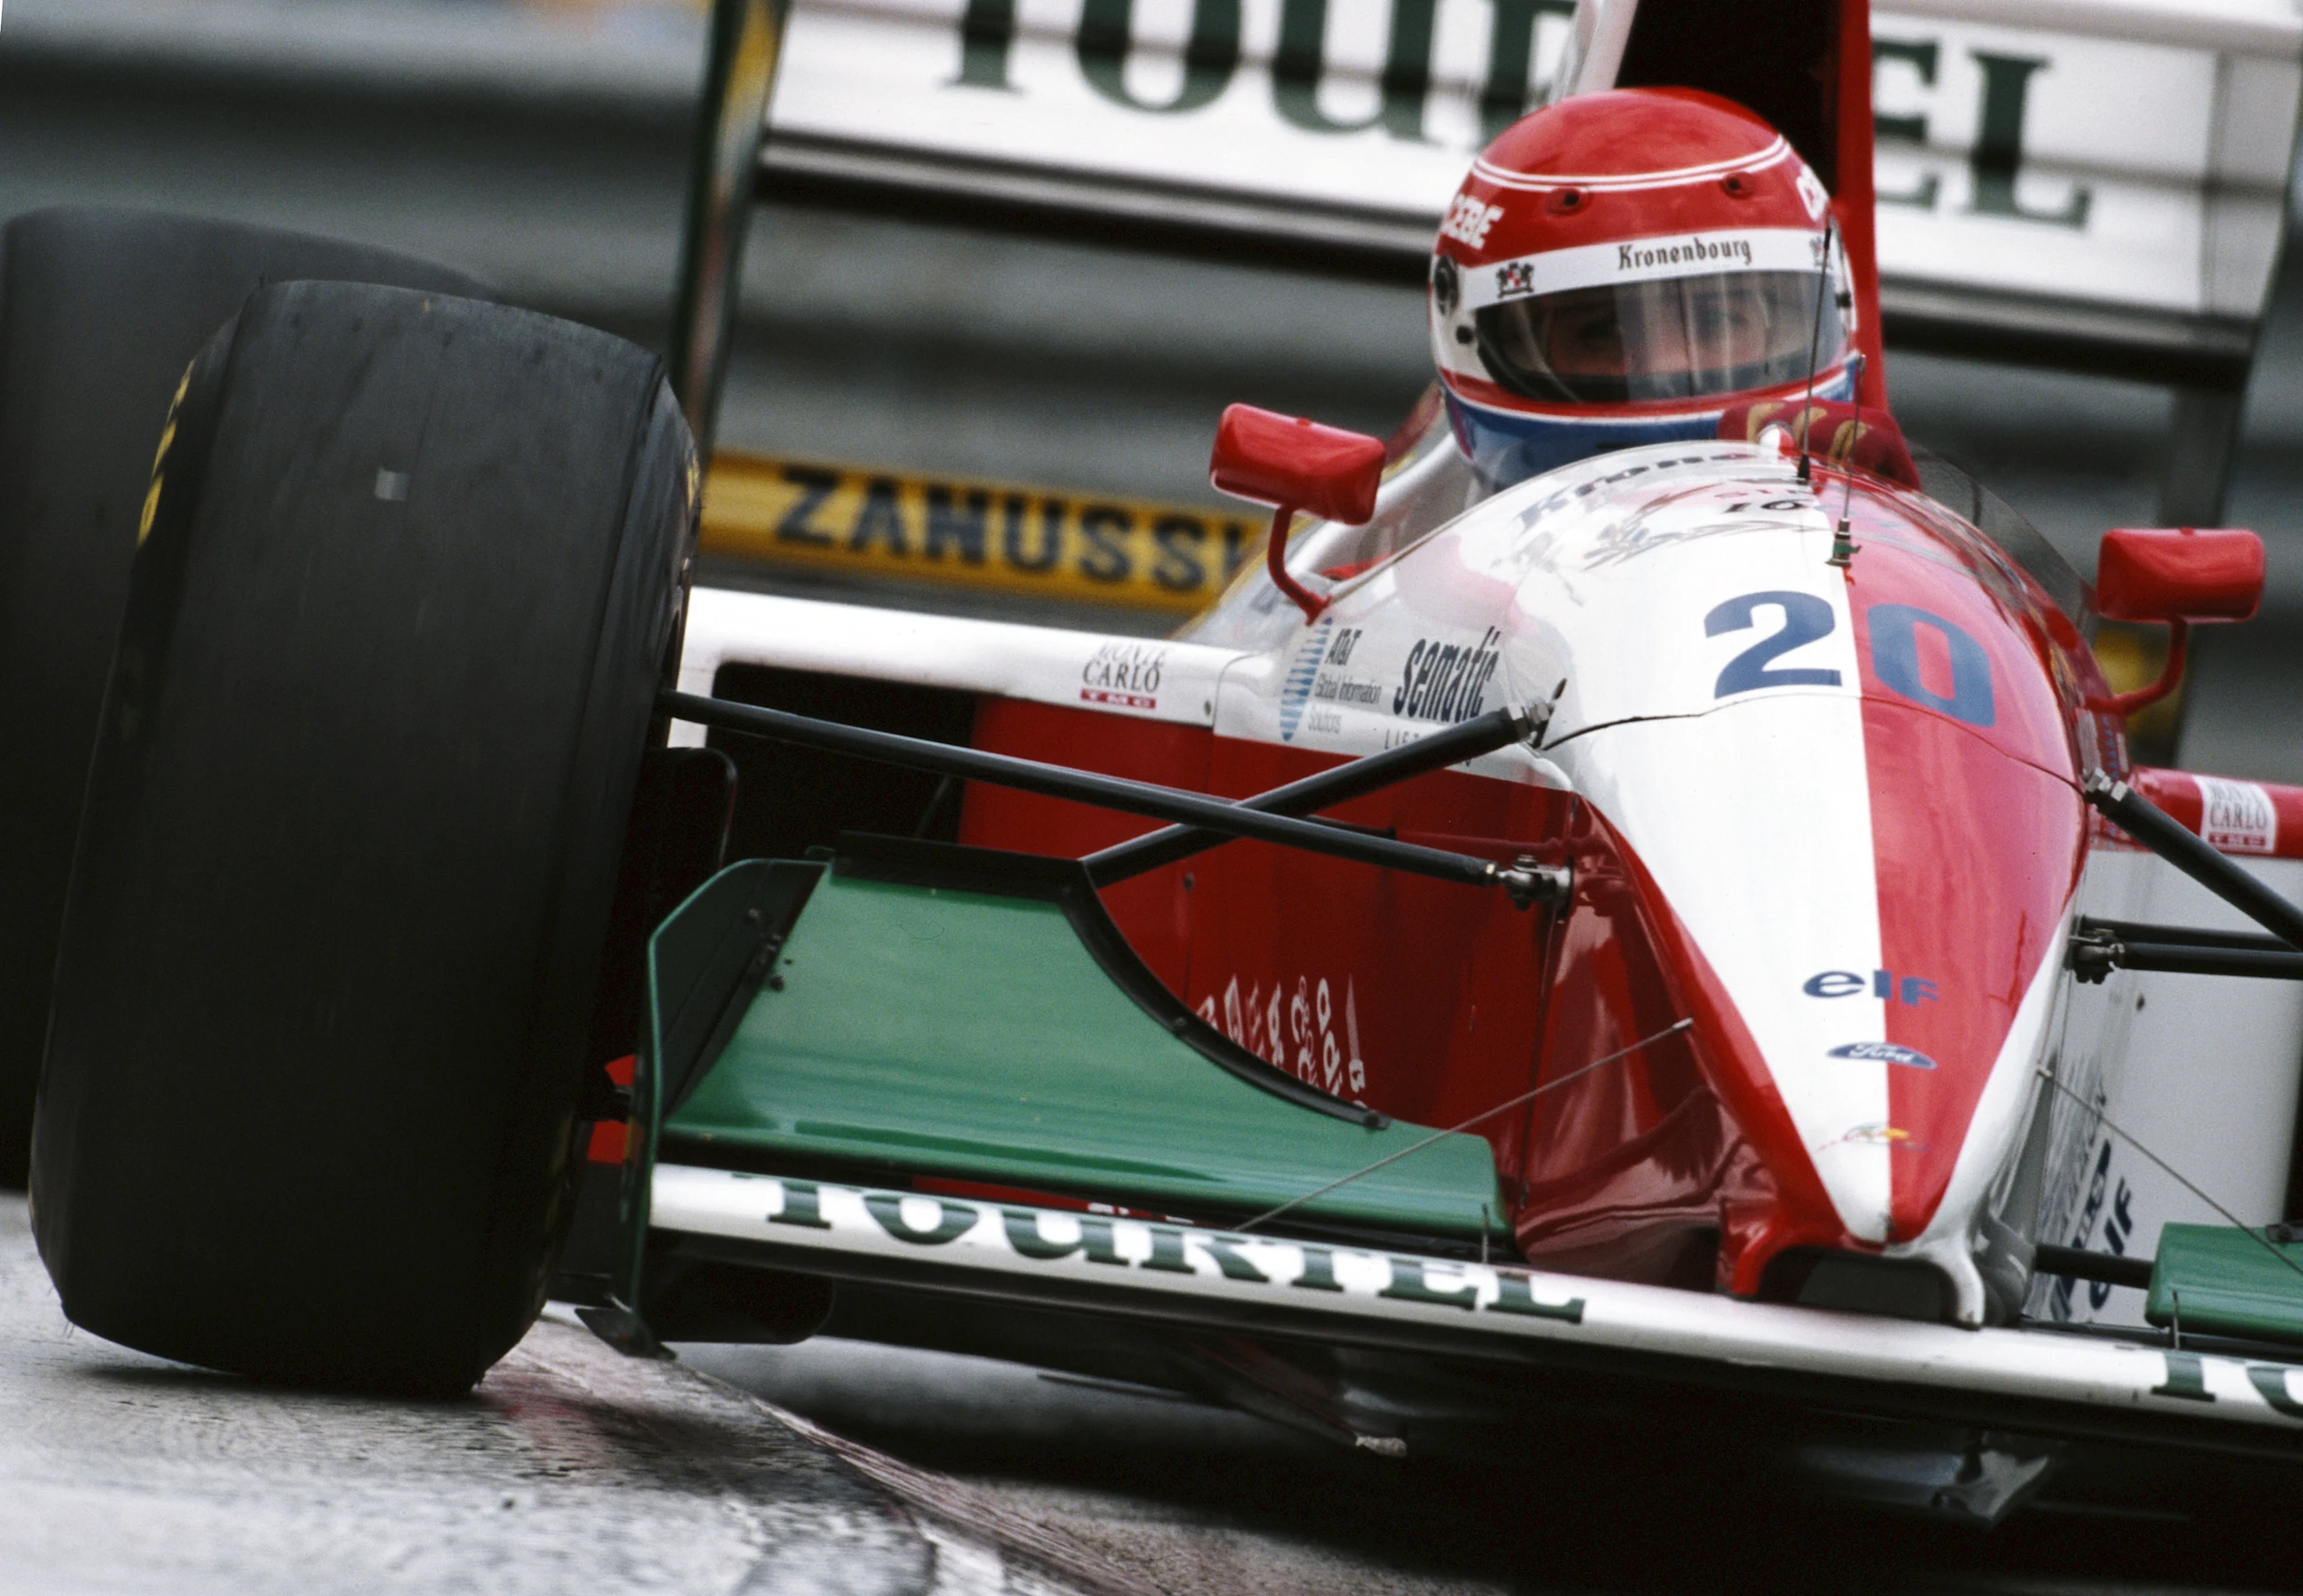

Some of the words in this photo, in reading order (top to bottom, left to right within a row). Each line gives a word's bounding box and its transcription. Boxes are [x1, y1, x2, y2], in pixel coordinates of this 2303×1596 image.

[1618, 237, 1752, 270] Kronenbourg
[1082, 658, 1161, 693] CARLO
[1704, 591, 1995, 727] 20
